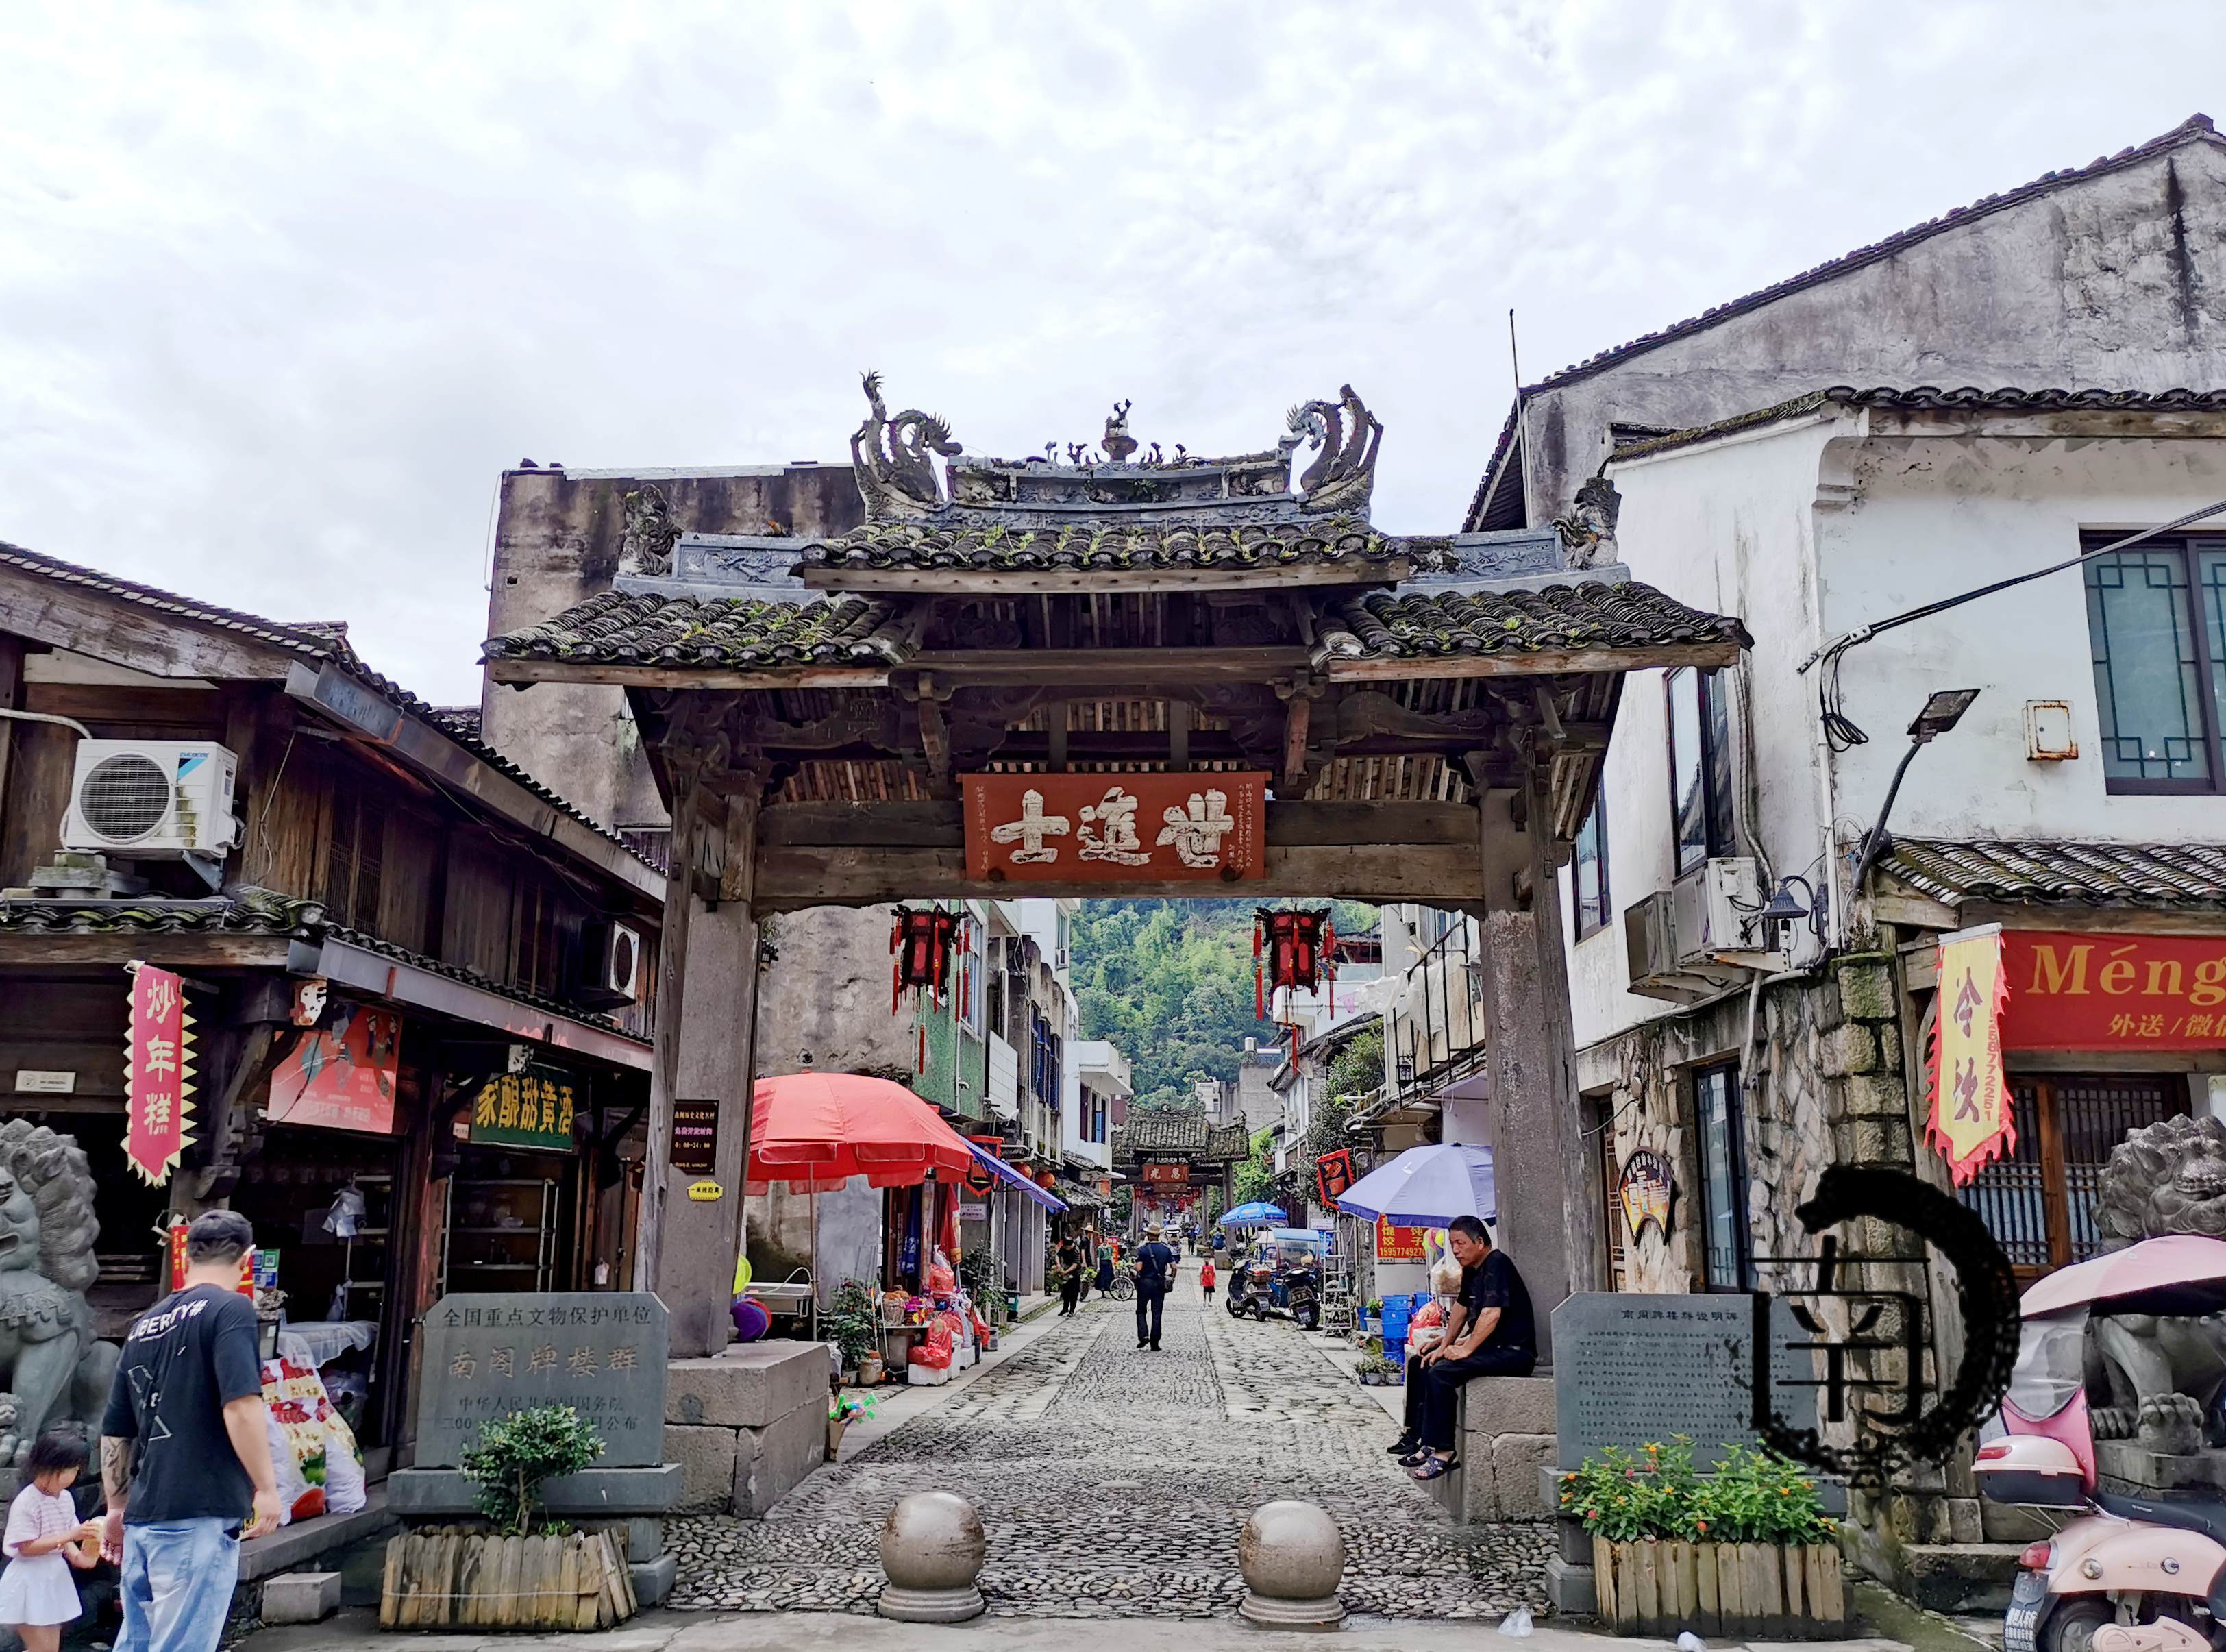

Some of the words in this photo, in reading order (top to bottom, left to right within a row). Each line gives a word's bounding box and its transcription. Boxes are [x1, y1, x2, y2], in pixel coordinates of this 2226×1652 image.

[2025, 944, 2226, 1006] Méng
[144, 978, 177, 1135] 炒年糕
[443, 1307, 652, 1327] 全国重点文物保护单位
[447, 1343, 639, 1380] 南阁牌楼群
